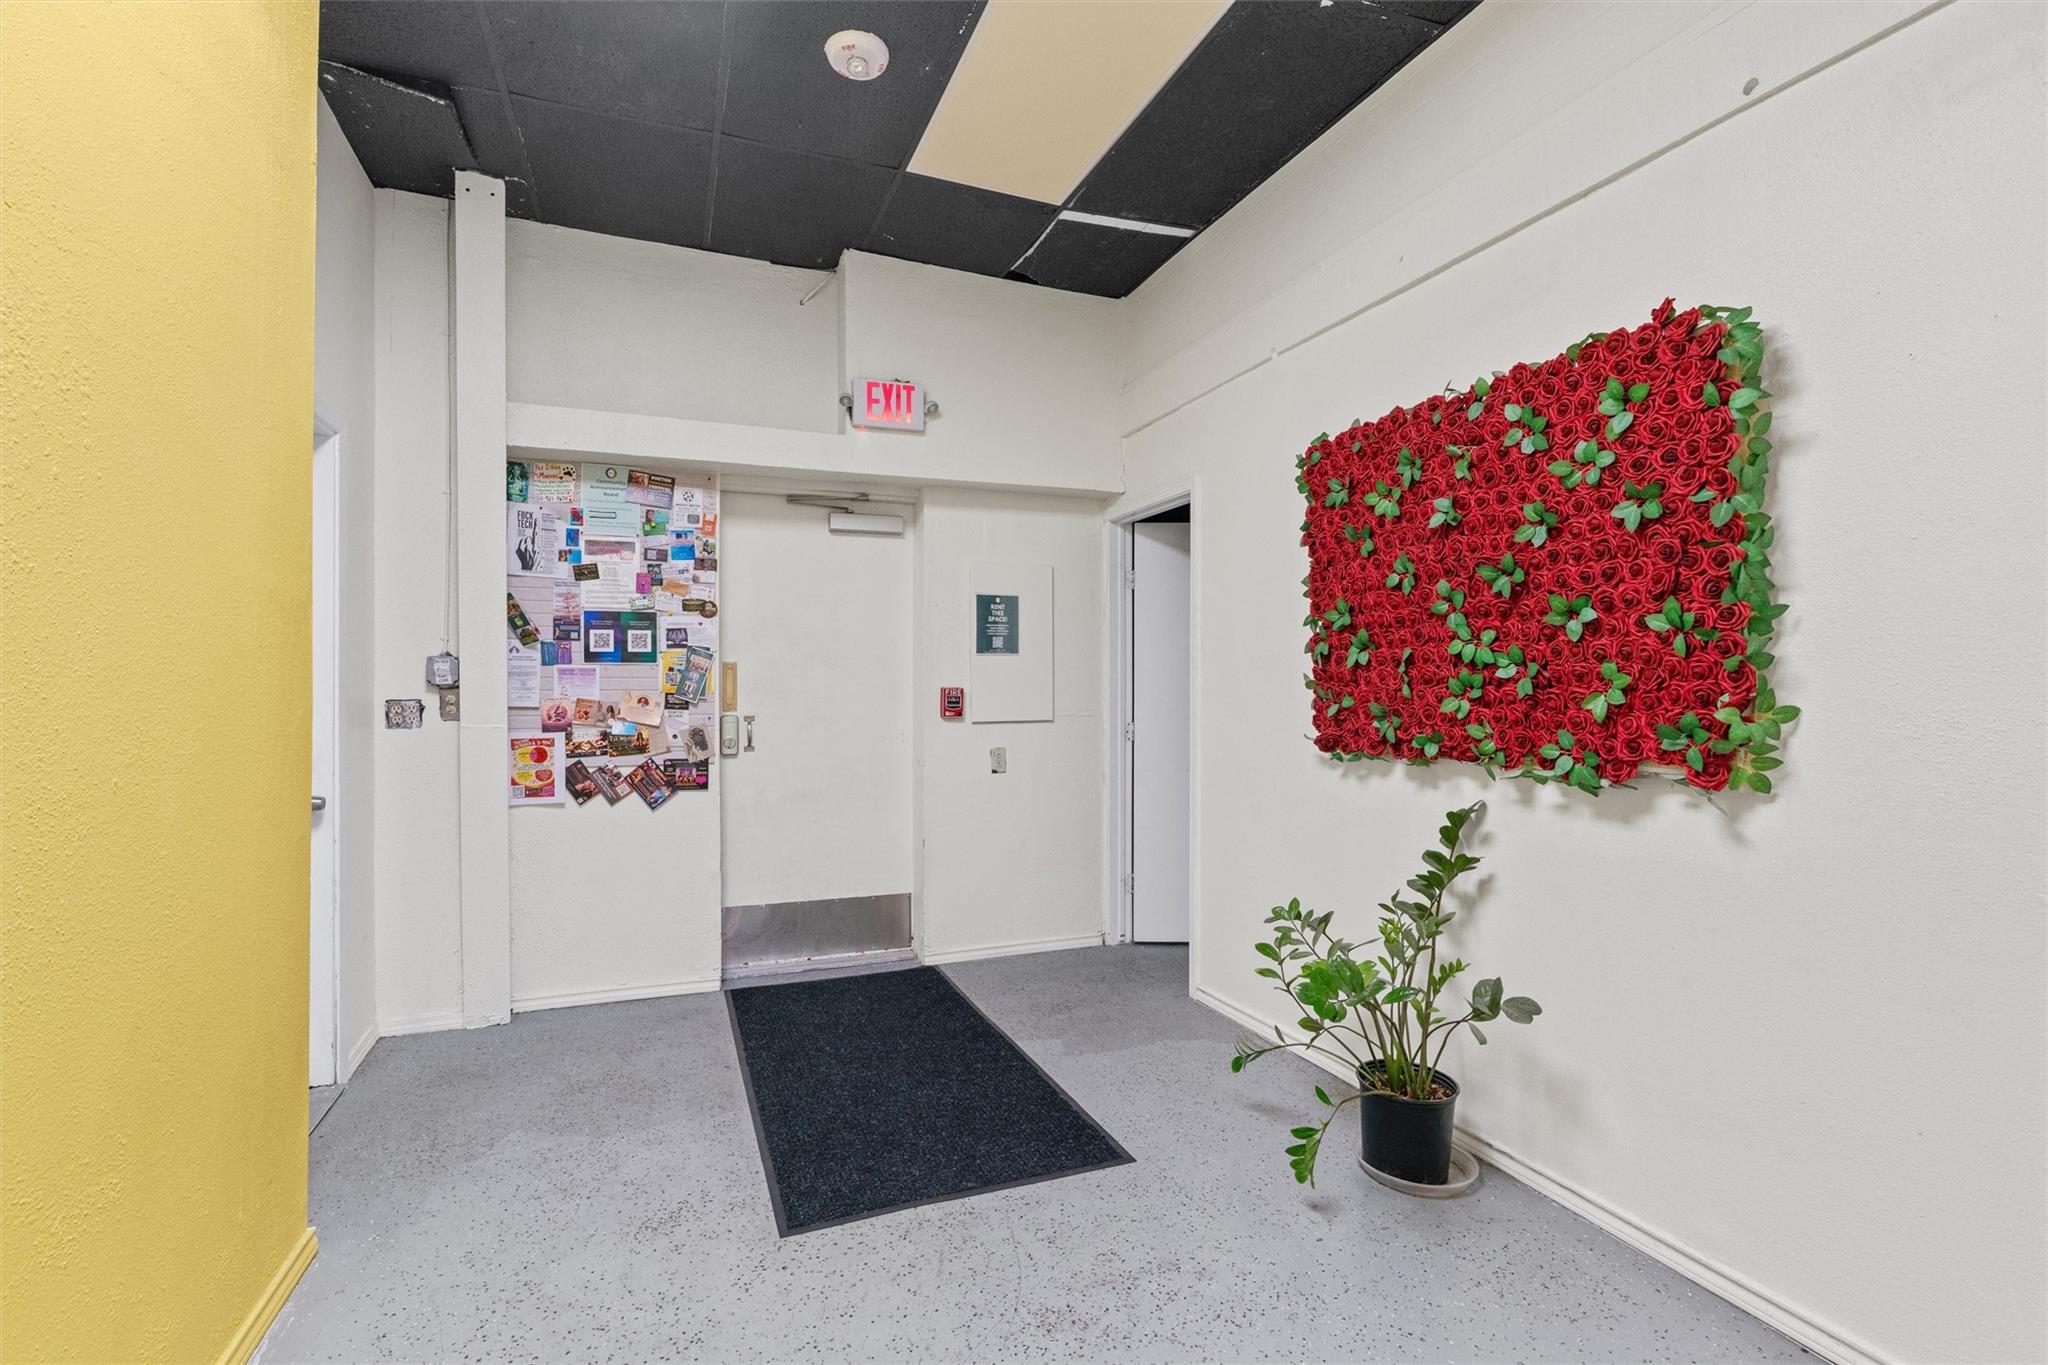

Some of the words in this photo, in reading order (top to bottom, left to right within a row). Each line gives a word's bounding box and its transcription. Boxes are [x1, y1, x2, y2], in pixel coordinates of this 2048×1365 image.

[866, 381, 915, 424] EXIT
[517, 510, 534, 520] FUCK
[517, 519, 533, 529] TECH
